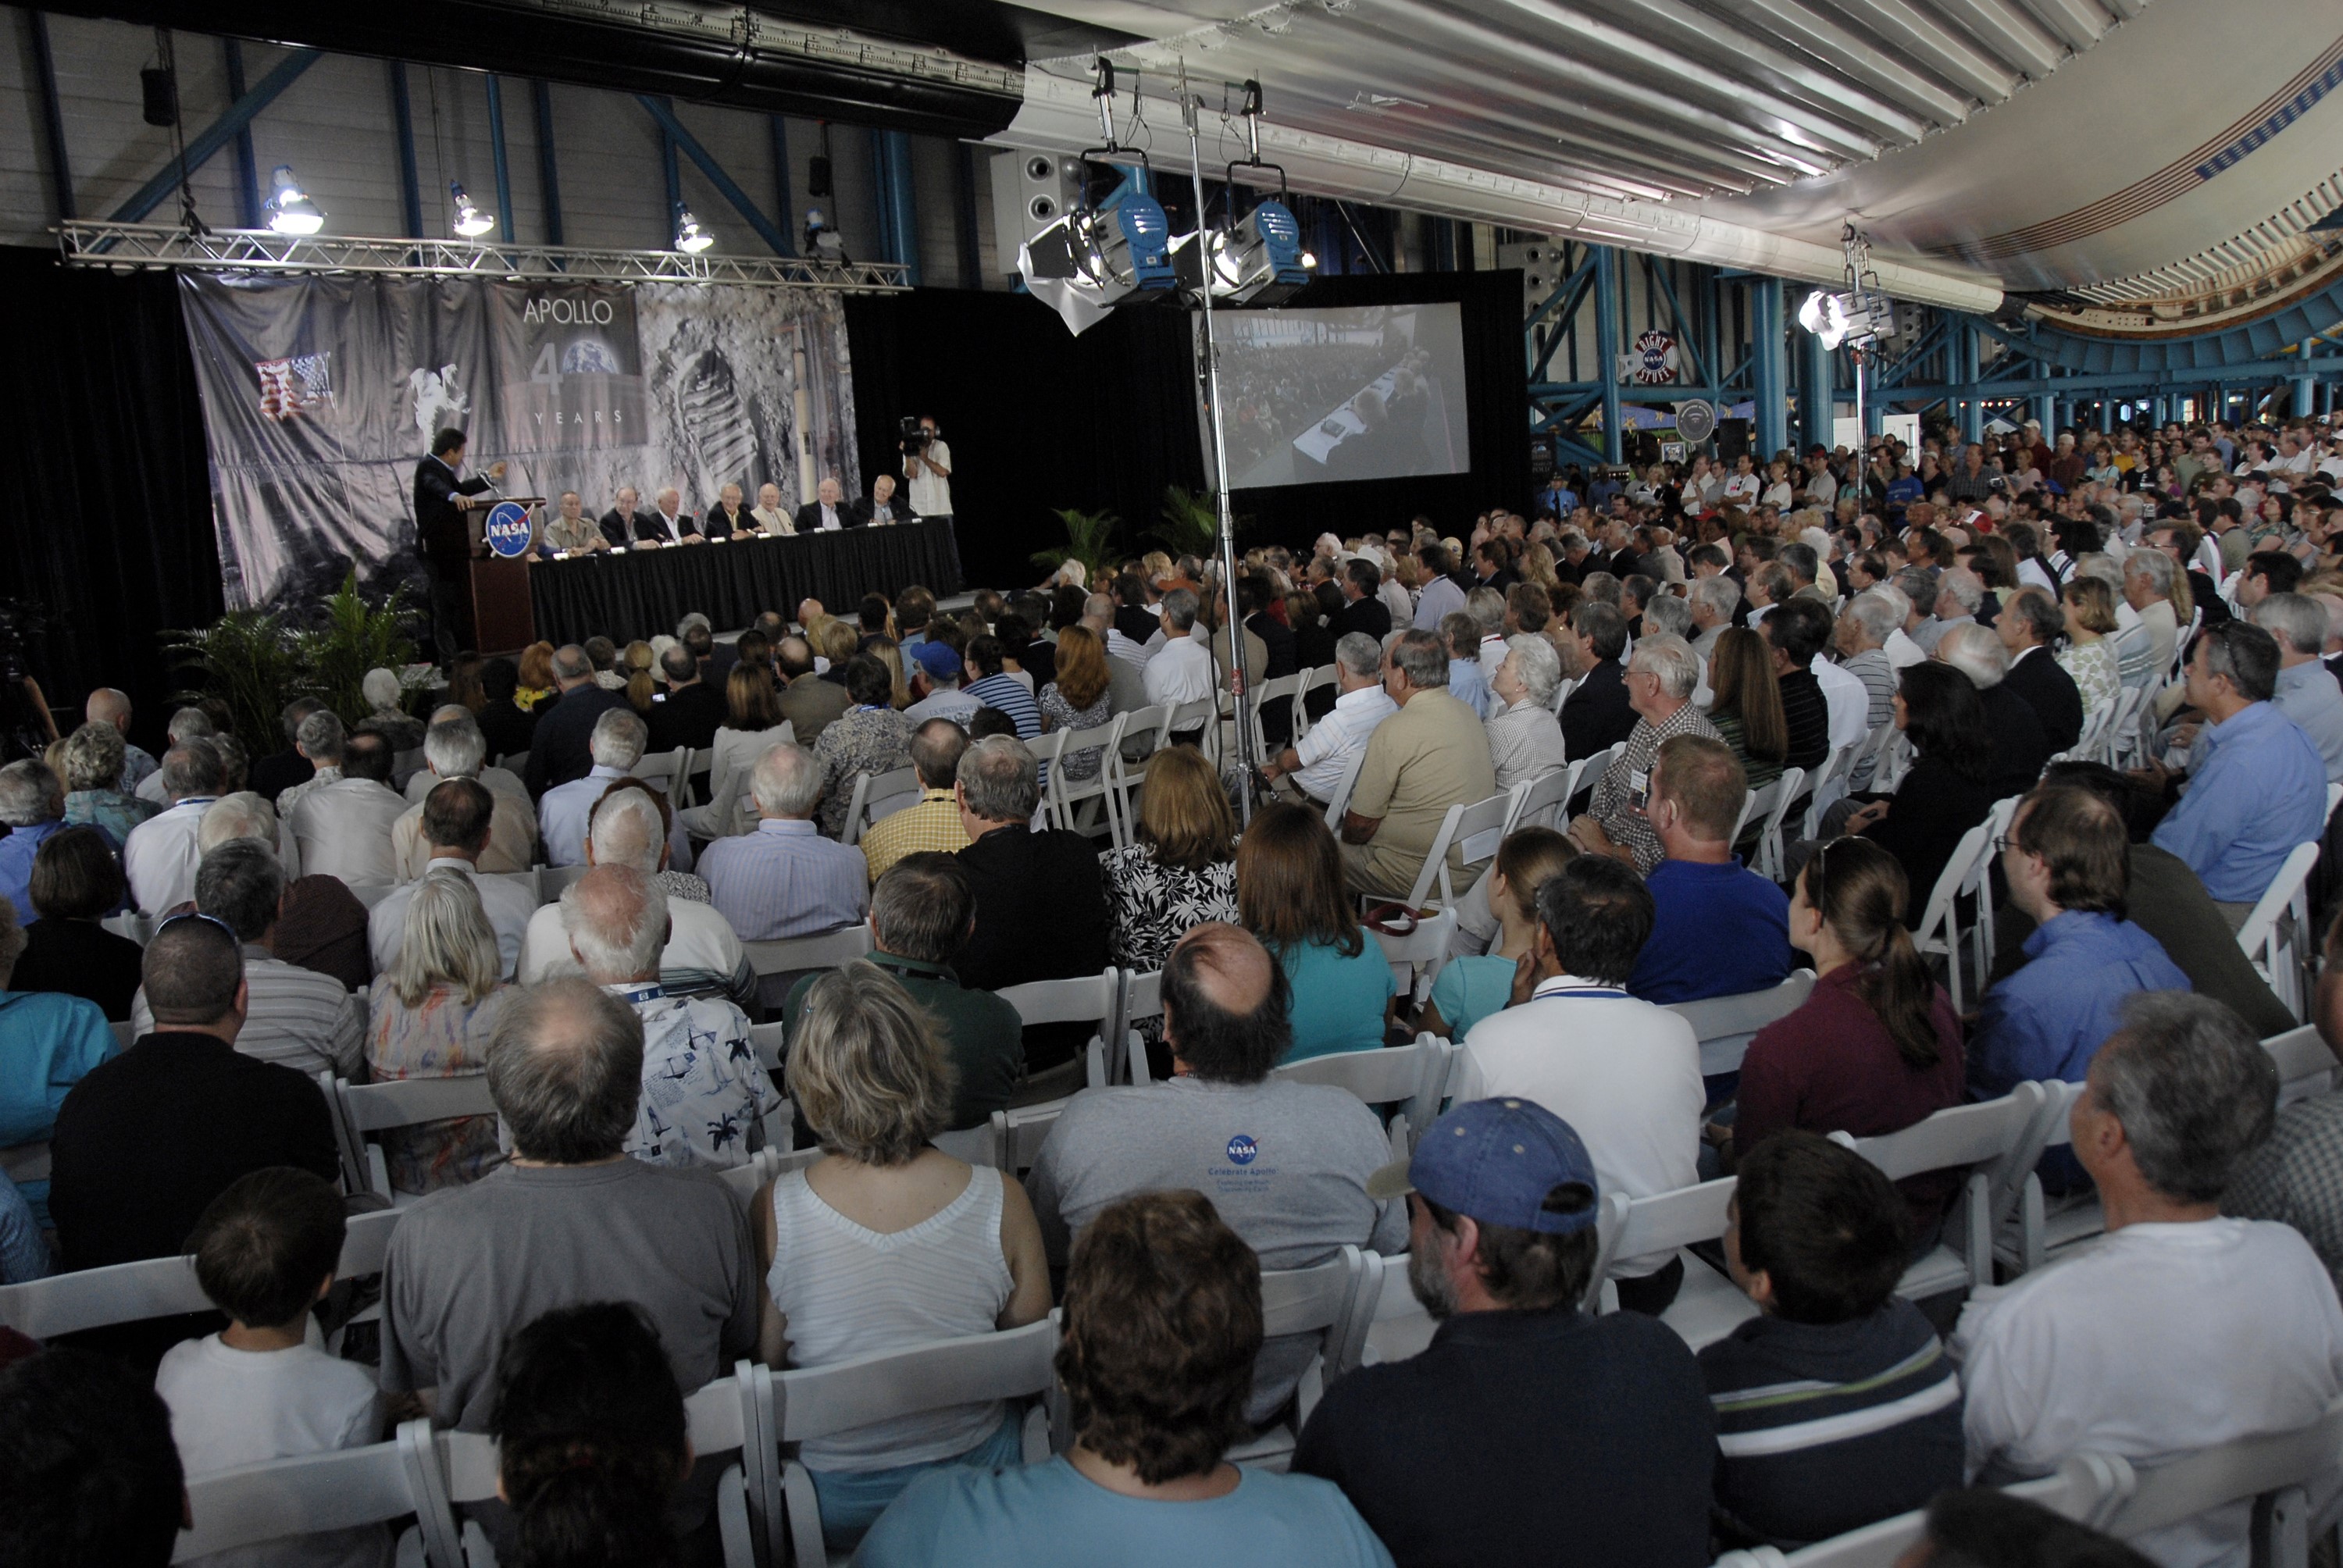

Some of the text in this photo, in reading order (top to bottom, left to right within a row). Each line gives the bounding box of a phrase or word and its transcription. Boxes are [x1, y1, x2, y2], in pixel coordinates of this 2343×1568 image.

[523, 298, 613, 325] APOLLO
[1639, 335, 1667, 351] RIGHT
[1639, 367, 1670, 383] STUFF
[534, 410, 622, 425] YEARS
[490, 522, 530, 536] NASA
[1229, 1146, 1256, 1155] NASA
